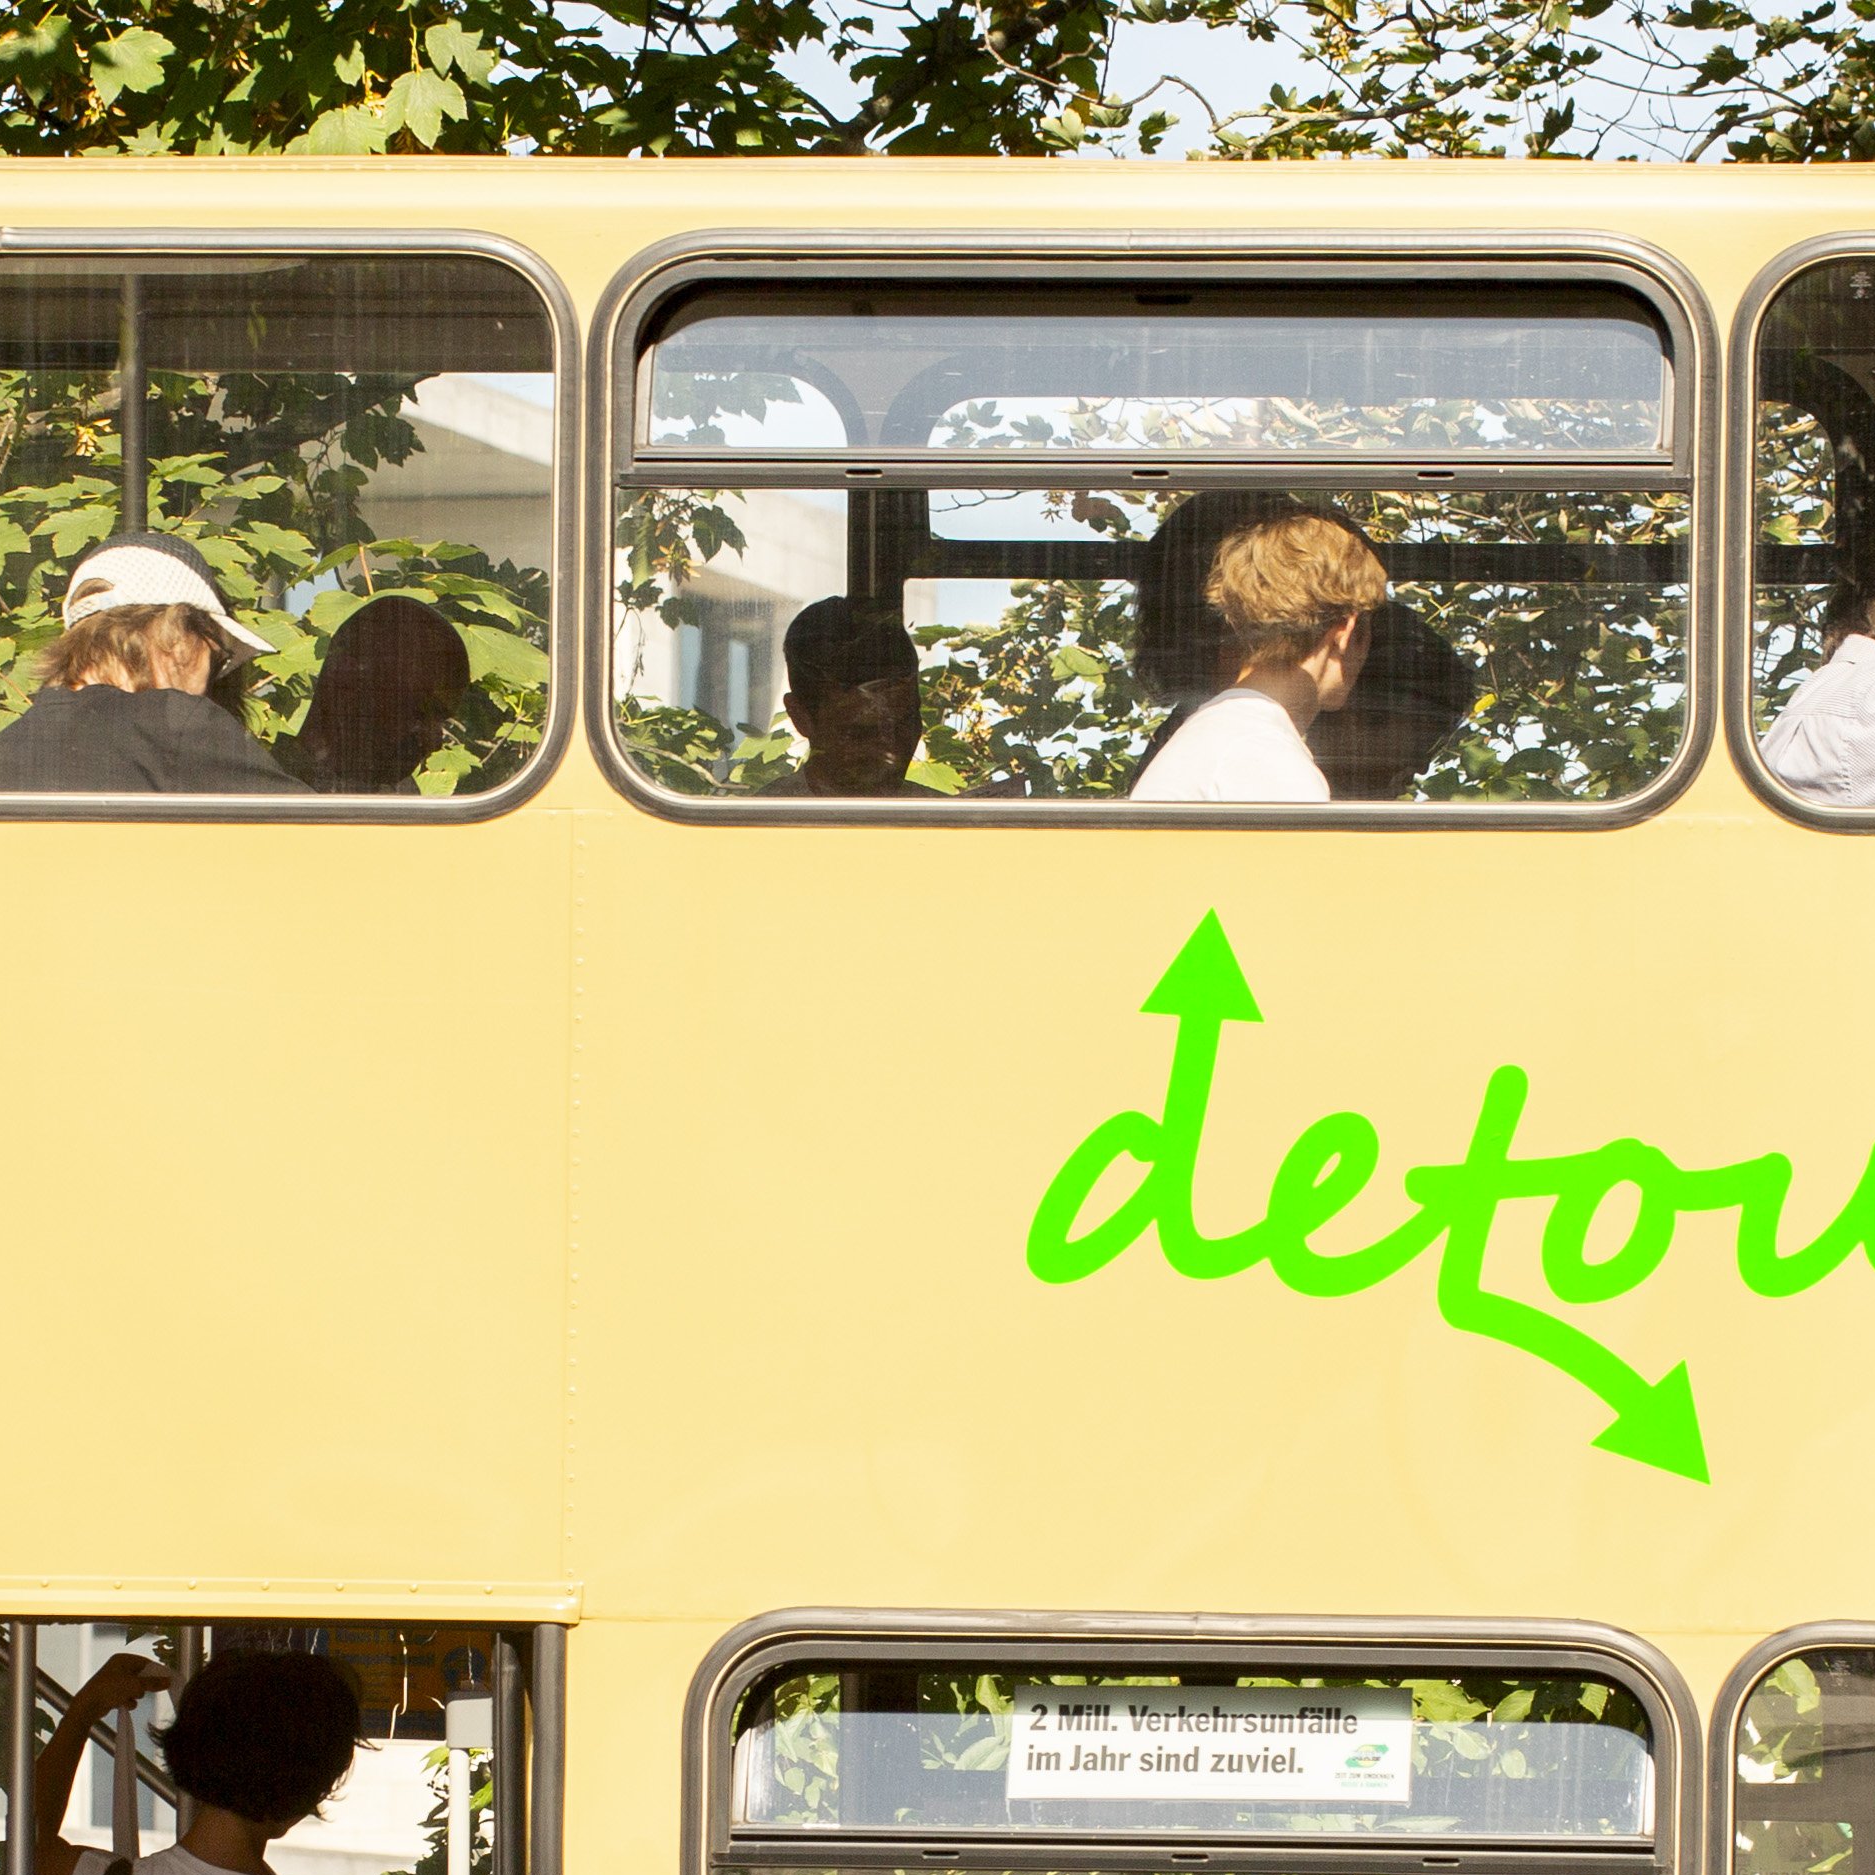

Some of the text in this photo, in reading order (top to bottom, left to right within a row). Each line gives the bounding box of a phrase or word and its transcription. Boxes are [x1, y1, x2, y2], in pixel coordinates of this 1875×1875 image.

[1030, 1703, 1358, 1734] 2 Mill. Verkehrsunfälle
[1027, 1745, 1304, 1774] im Jahr sind zuviel.
